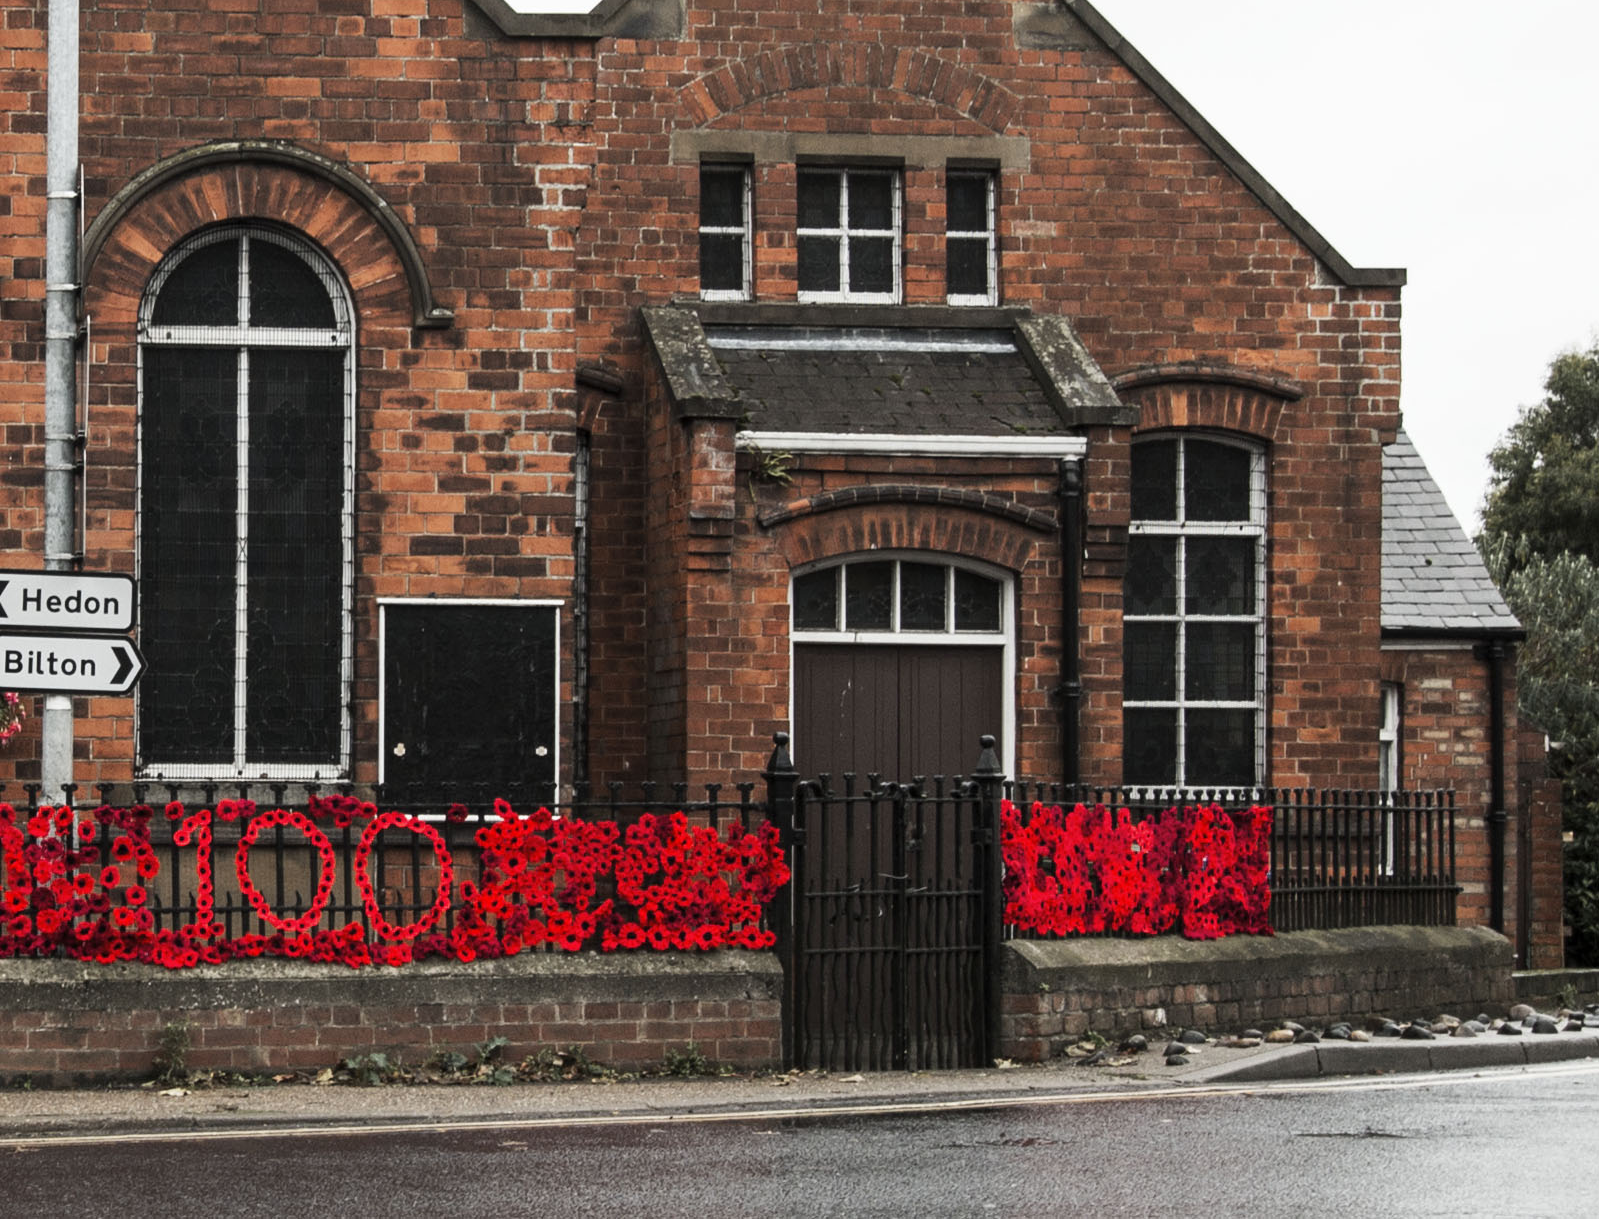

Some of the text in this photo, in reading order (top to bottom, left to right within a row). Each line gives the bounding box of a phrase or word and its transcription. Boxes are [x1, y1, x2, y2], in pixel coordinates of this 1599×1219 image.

[22, 588, 119, 615] Hedon
[4, 650, 96, 676] Bilton
[173, 808, 453, 941] 100
